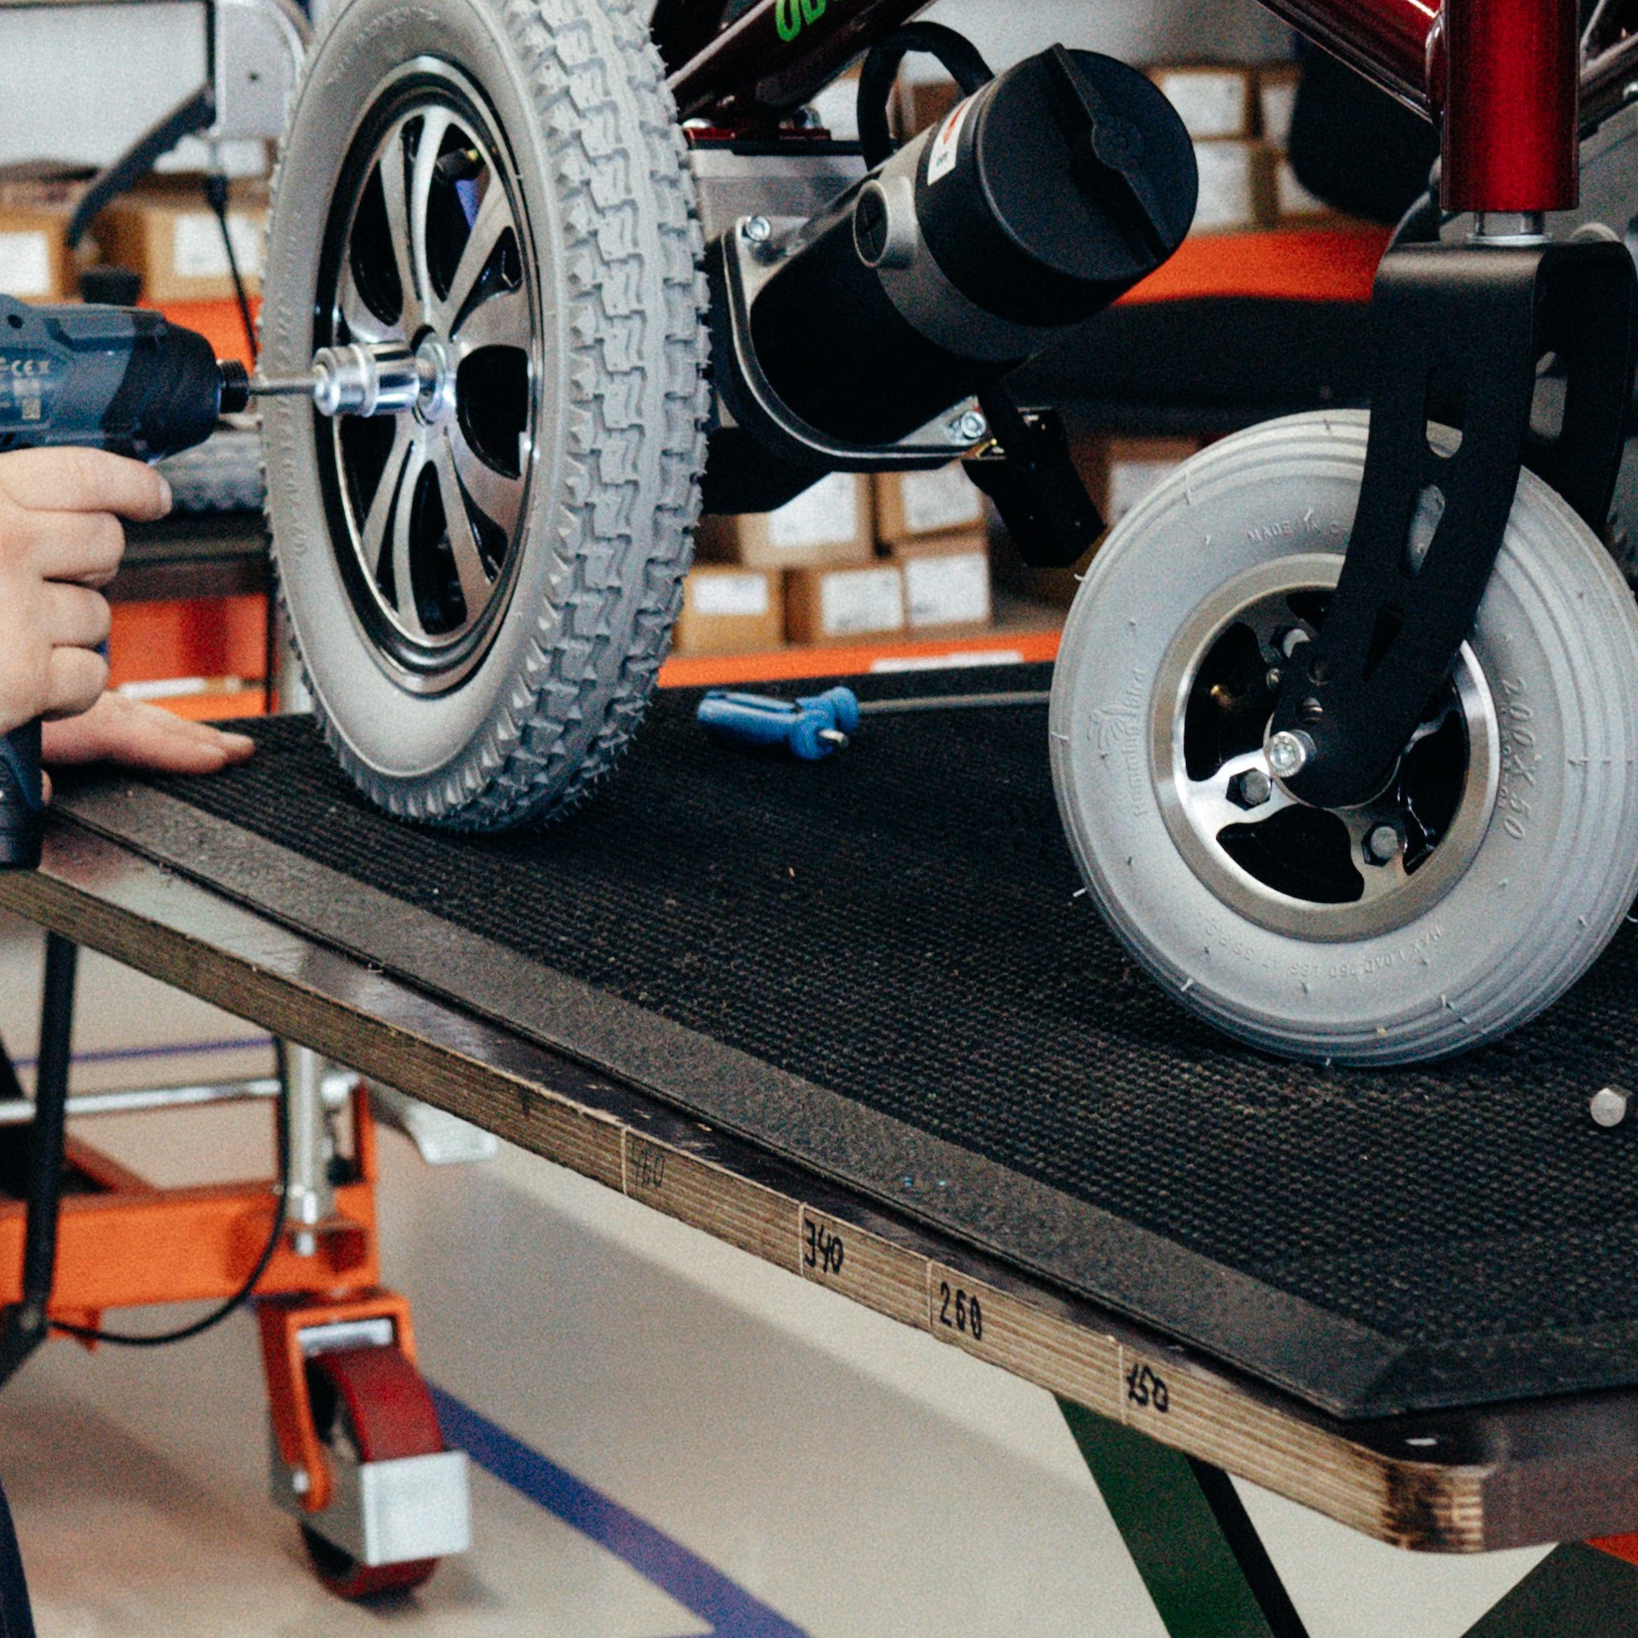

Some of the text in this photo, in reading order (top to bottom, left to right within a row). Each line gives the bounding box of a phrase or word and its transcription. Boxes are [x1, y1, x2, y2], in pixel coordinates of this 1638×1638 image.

[804, 1218, 845, 1275] 340
[939, 1281, 983, 1341] 260
[1126, 1363, 1170, 1414] 150
